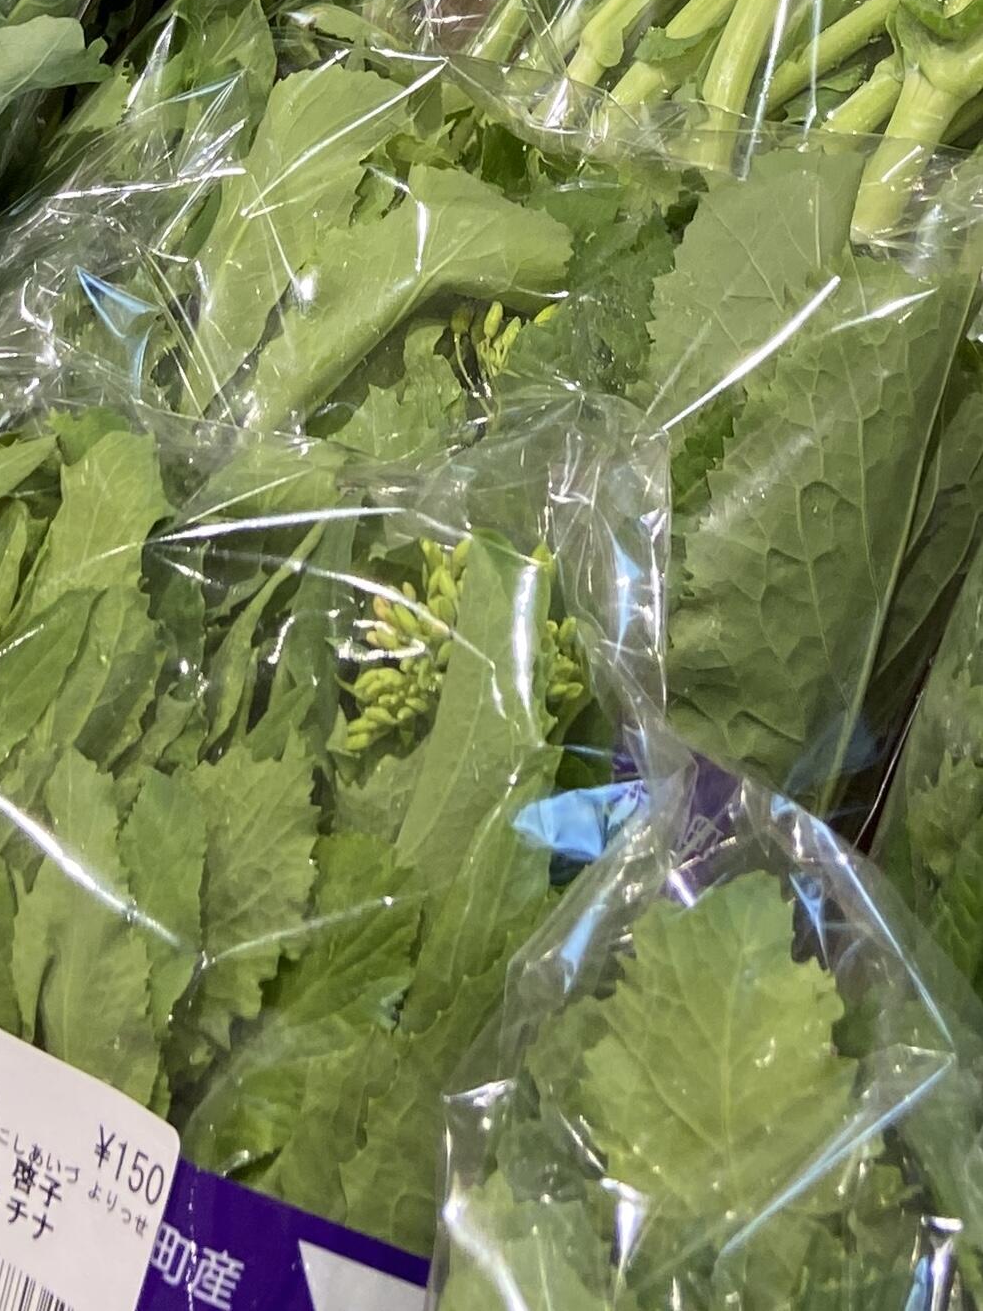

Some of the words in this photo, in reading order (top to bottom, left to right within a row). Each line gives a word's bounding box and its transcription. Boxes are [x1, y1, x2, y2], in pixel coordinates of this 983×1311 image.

[94, 1123, 165, 1207] ¥150
[88, 1182, 149, 1238] よりっせ
